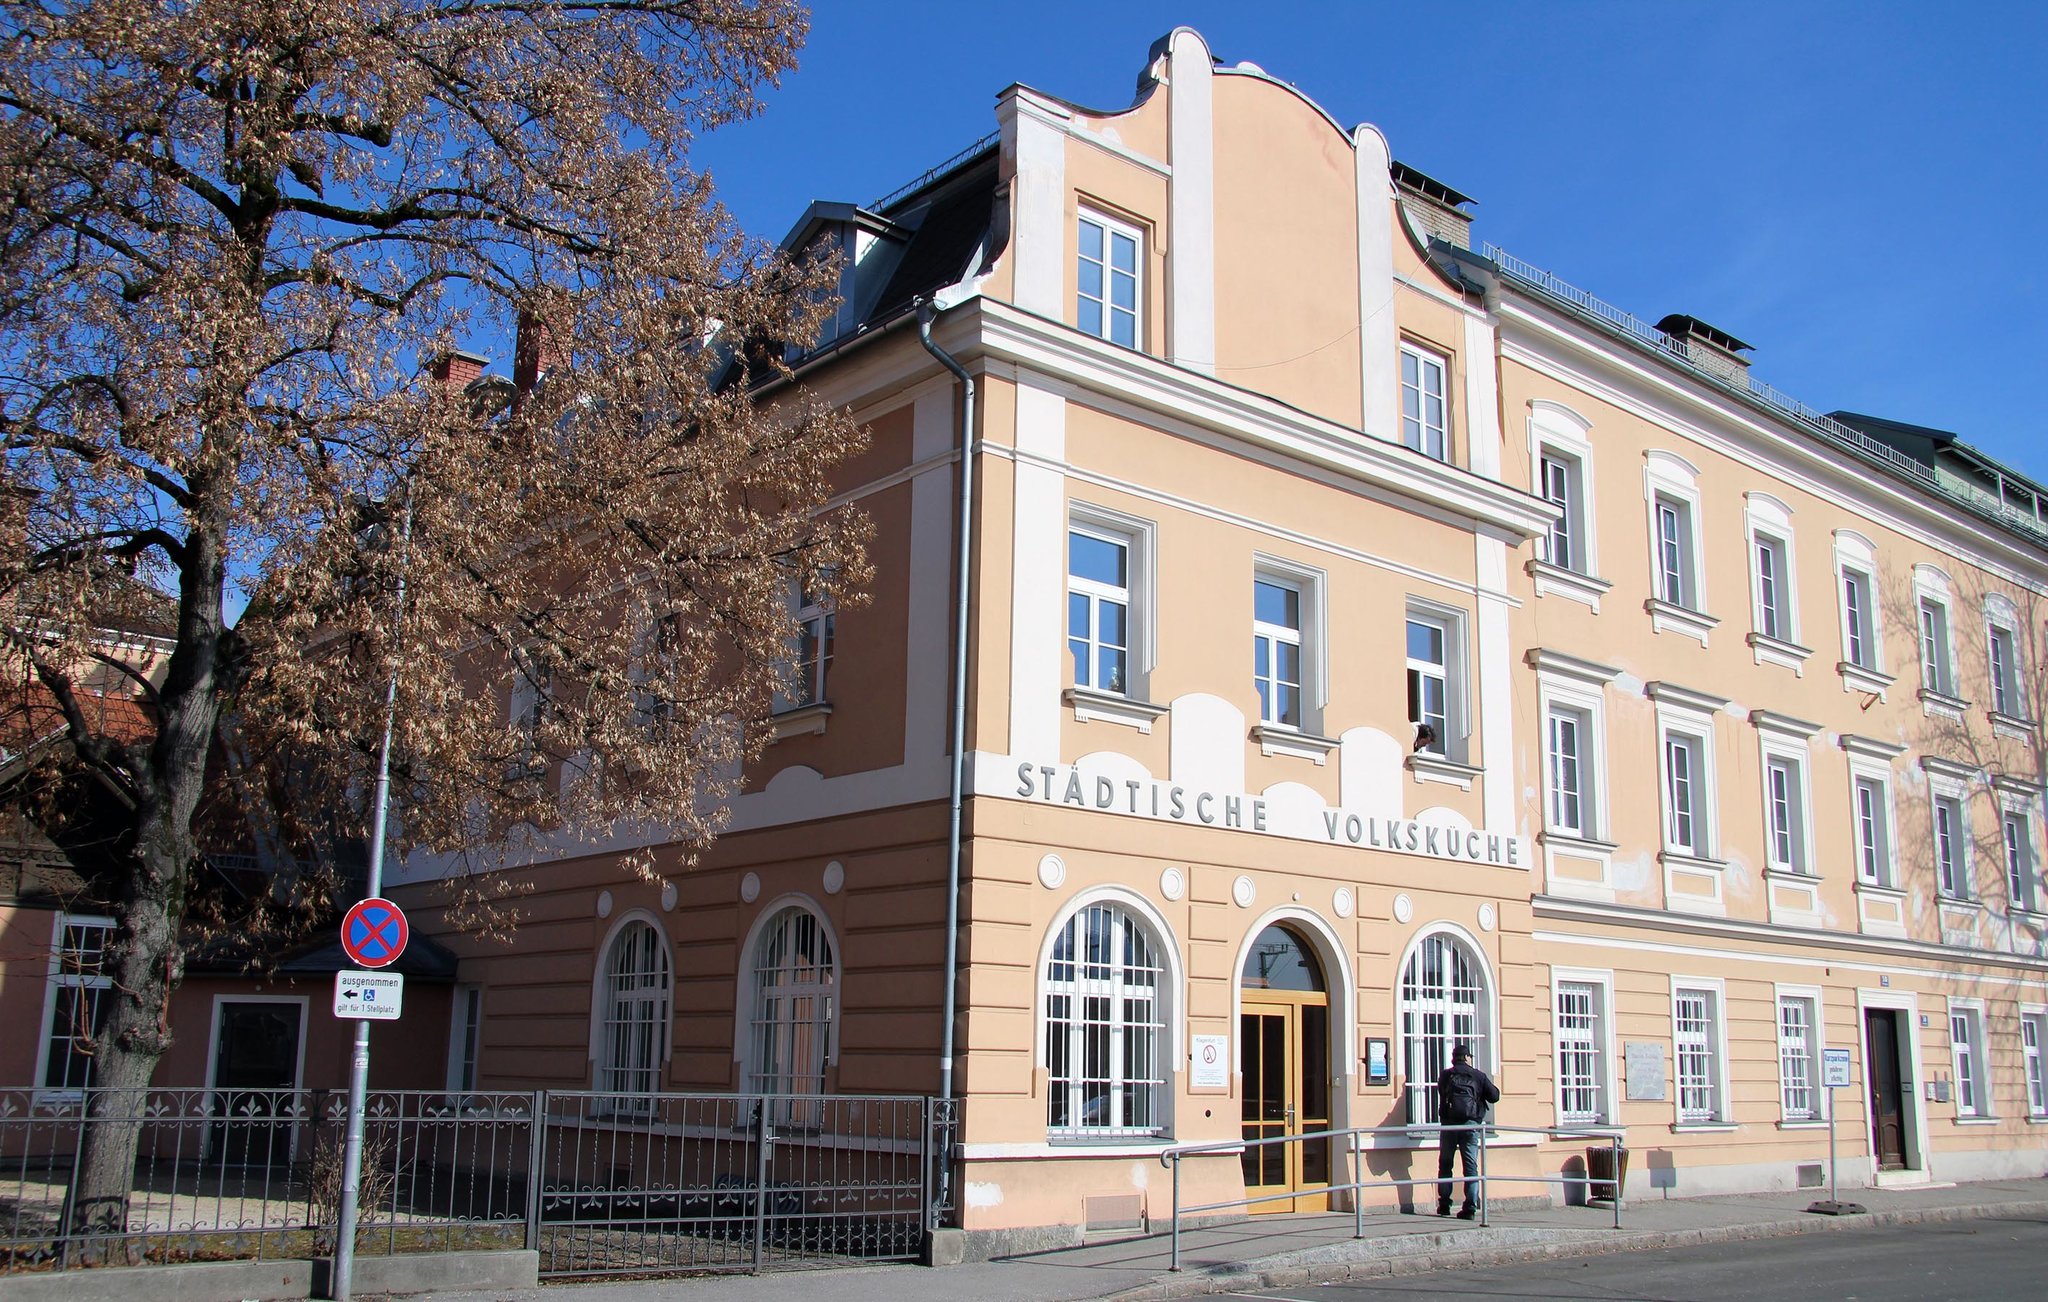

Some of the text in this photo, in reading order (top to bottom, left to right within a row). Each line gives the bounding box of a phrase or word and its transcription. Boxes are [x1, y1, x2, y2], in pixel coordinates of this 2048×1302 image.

[1016, 761, 1517, 865] STÄDTISCHE VOLKSKÜCHE
[342, 977, 399, 988] ausgenommen
[337, 1004, 348, 1013] gilt
[350, 1004, 359, 1012] für
[366, 1005, 395, 1014] Stellplatz
